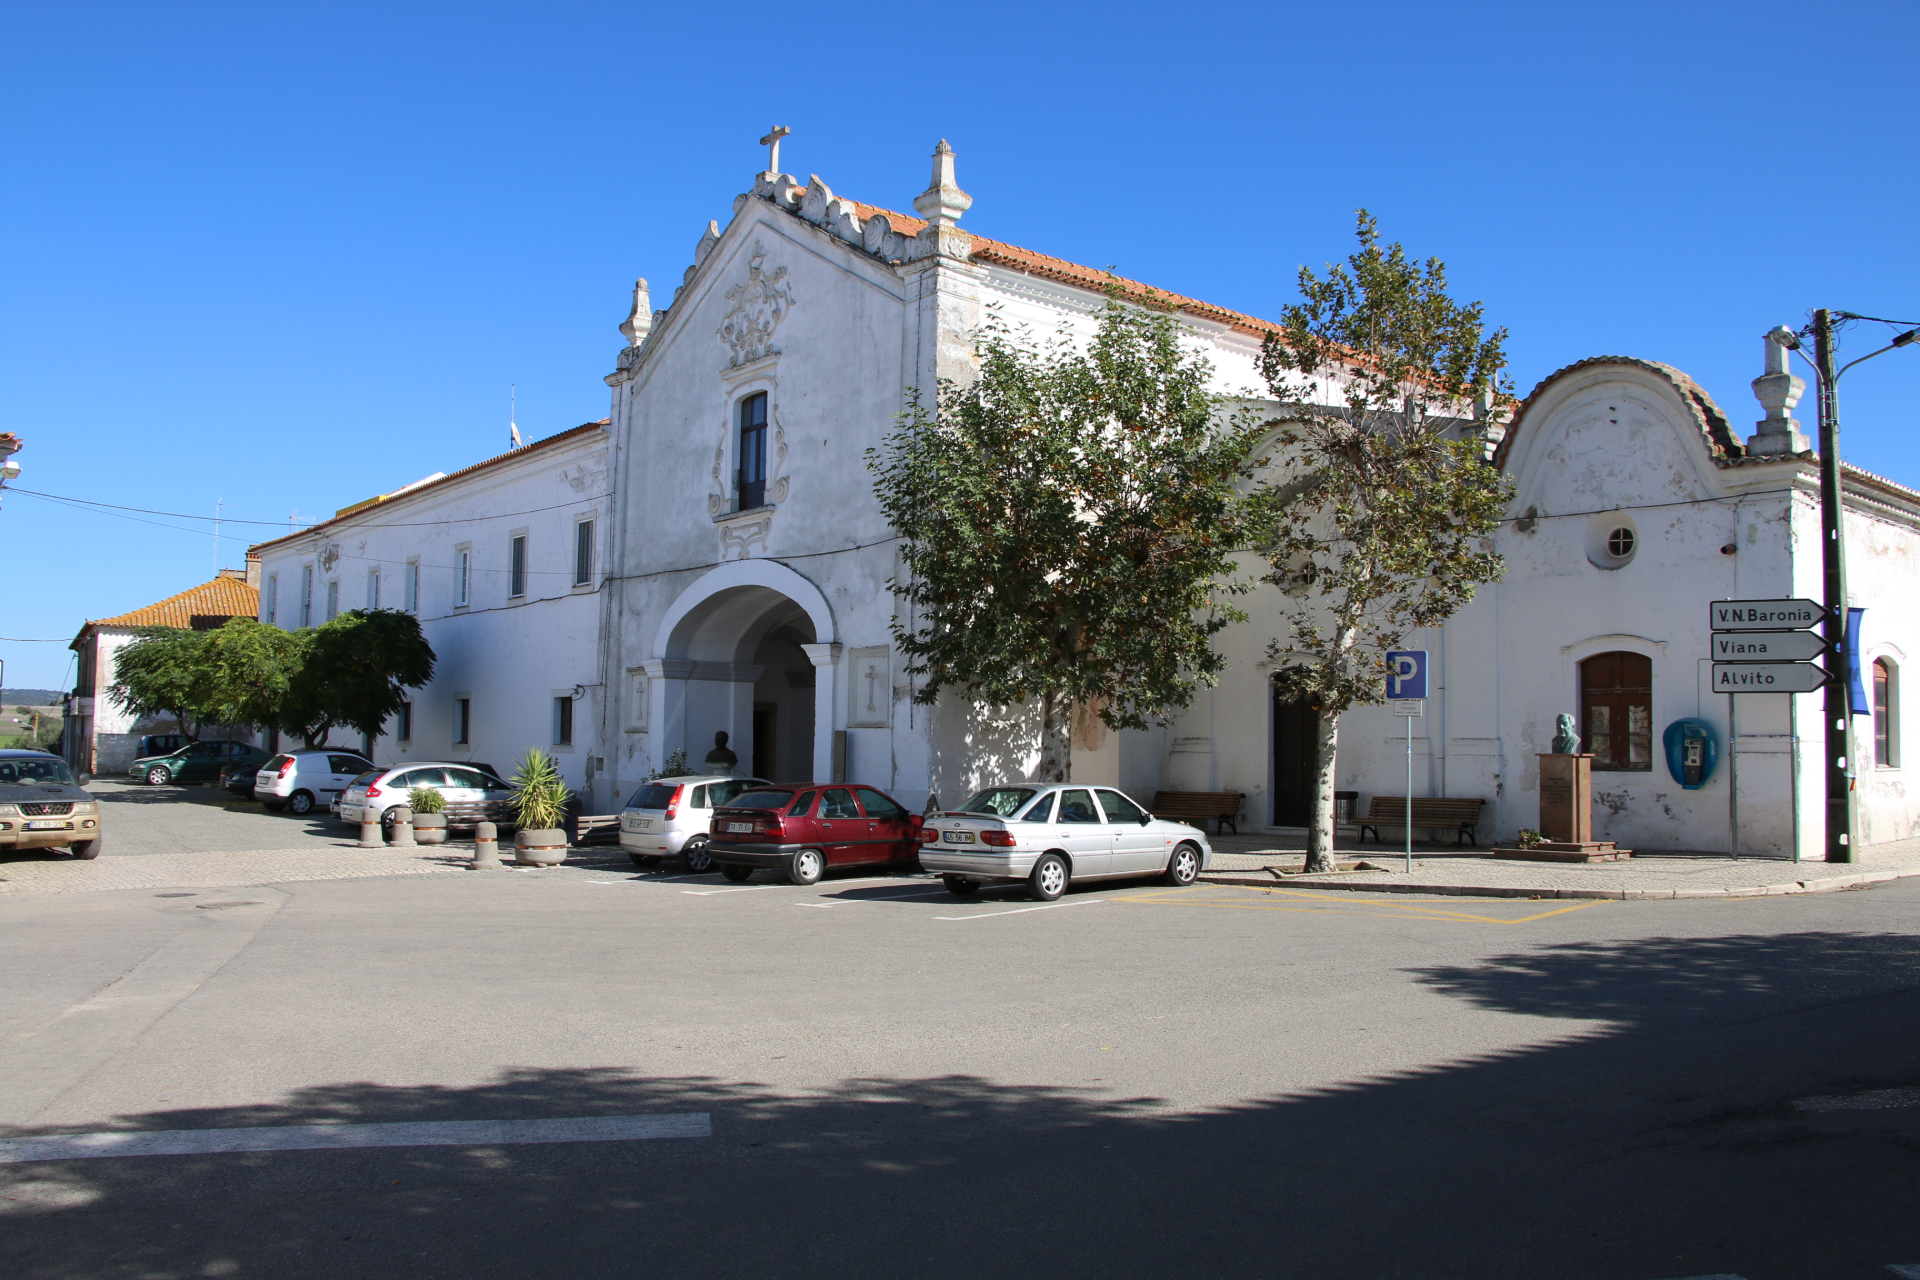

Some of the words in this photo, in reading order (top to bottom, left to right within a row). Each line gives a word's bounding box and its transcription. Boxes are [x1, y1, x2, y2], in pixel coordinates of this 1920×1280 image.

[1720, 640, 1768, 653] Viana
[1395, 656, 1417, 694] P
[1720, 671, 1775, 685] Alvito
